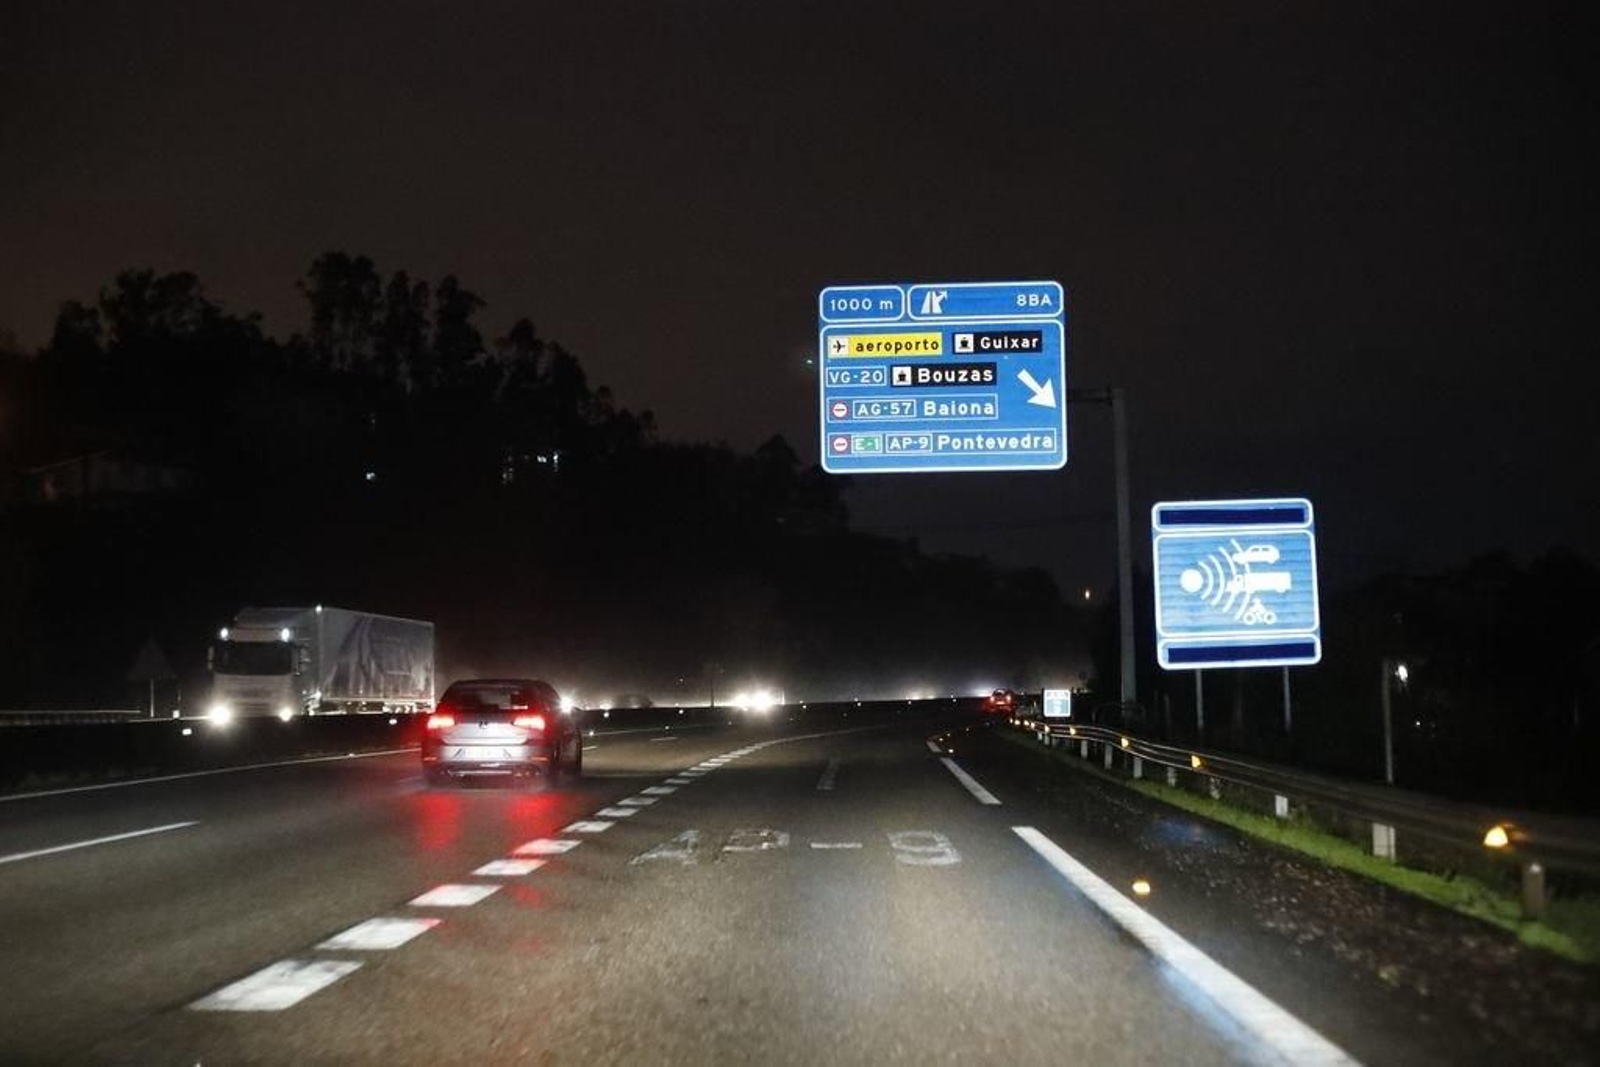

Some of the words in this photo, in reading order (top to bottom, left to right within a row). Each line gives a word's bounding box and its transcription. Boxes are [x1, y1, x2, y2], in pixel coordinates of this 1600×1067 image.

[830, 298, 872, 311] 1000
[879, 300, 894, 310] m
[1016, 294, 1052, 307] 8BA
[855, 339, 940, 354] aeroporto
[980, 336, 1039, 350] Guixar
[828, 370, 884, 384] VG-20
[917, 368, 994, 383] Bouzas
[857, 402, 912, 415] AG-57
[924, 400, 995, 416] Baiona
[889, 435, 929, 450] AP-9
[937, 434, 1053, 451] Pontevedra
